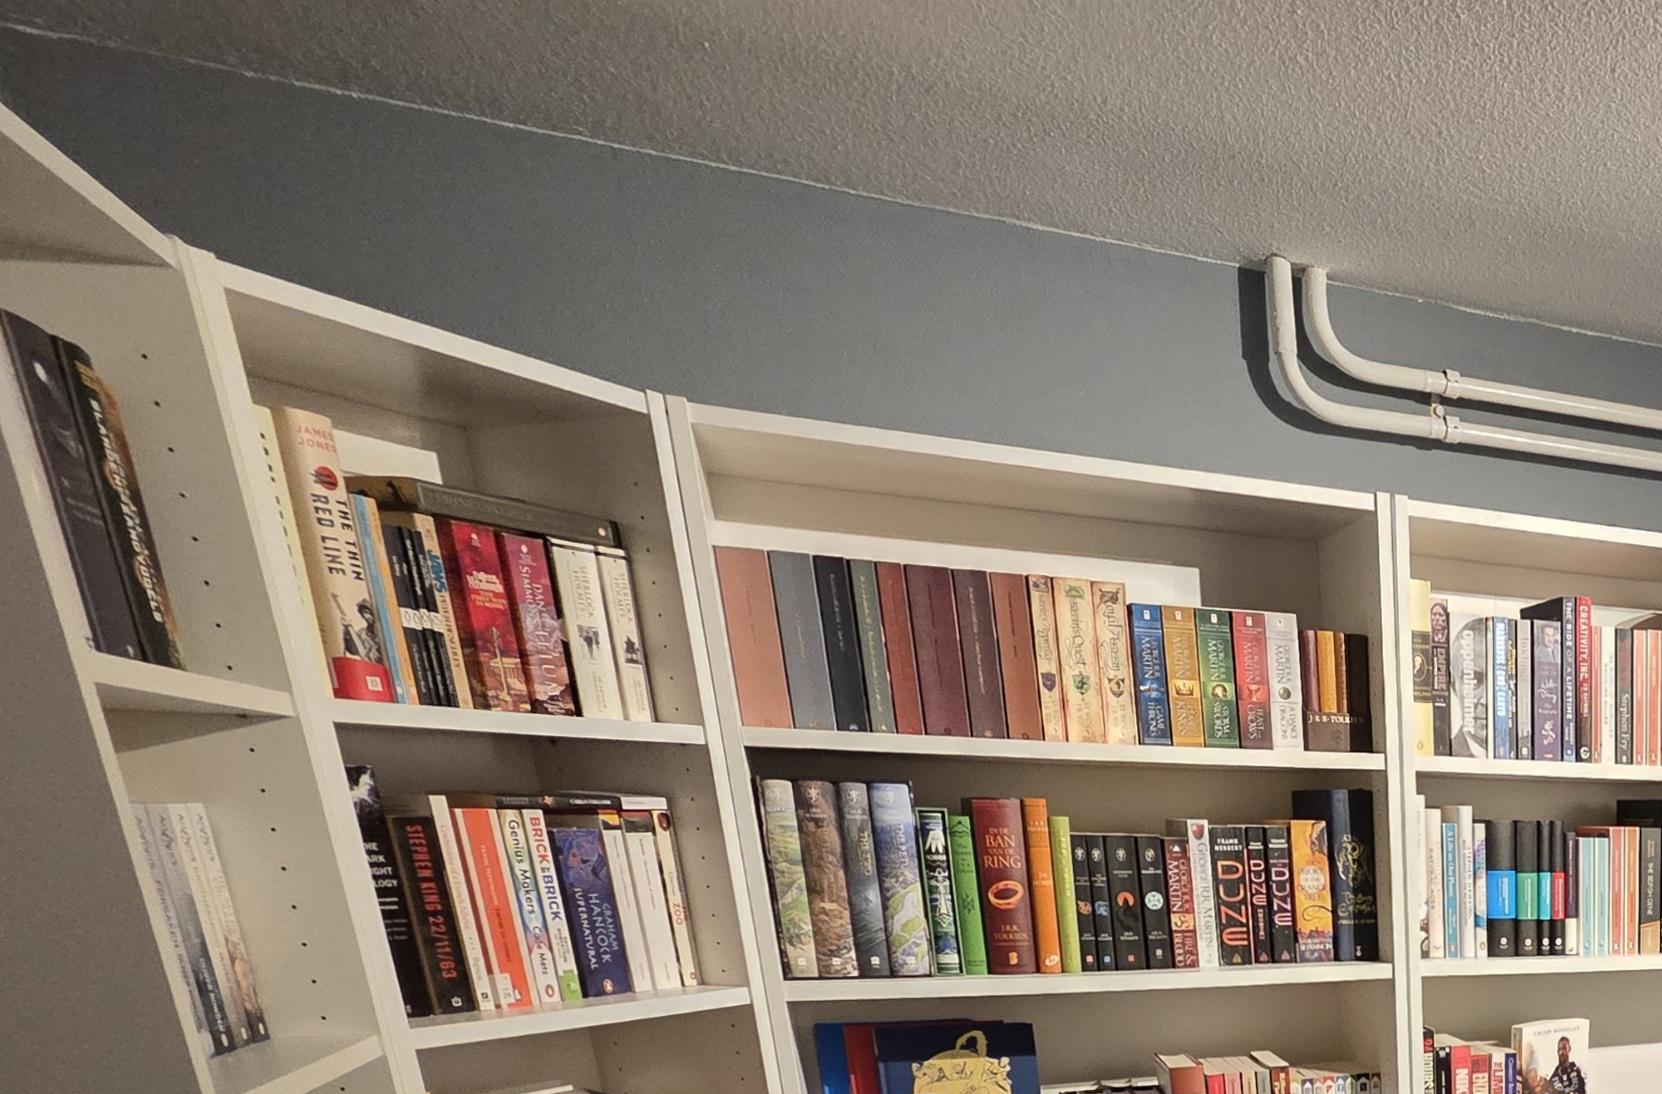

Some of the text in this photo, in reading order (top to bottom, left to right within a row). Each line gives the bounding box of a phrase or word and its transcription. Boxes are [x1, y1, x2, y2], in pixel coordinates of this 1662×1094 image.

[310, 493, 347, 576] RED LINE
[336, 500, 365, 582] THE THIN
[427, 549, 448, 593] JAWS
[520, 565, 539, 626] SIMMONS
[1141, 634, 1154, 679] MARTIN
[1207, 638, 1220, 681] MARTIN
[1459, 629, 1477, 734] oppenheimer
[508, 819, 523, 865] Genius
[519, 868, 536, 915] Makers
[529, 816, 562, 922] BRICK BRICK
[983, 853, 1022, 869] RING
[984, 834, 1016, 847] BAN
[406, 824, 457, 979] STEPHEN KING 22/11/63
[1167, 860, 1182, 912] MARTIN
[1216, 860, 1249, 946] DUNE
[1249, 859, 1267, 906] DUNE
[1270, 866, 1294, 927] DUNE
[573, 887, 600, 970] SUPERNATURAL
[587, 893, 613, 963] HANCOCK
[601, 902, 620, 951] GRAHAM
